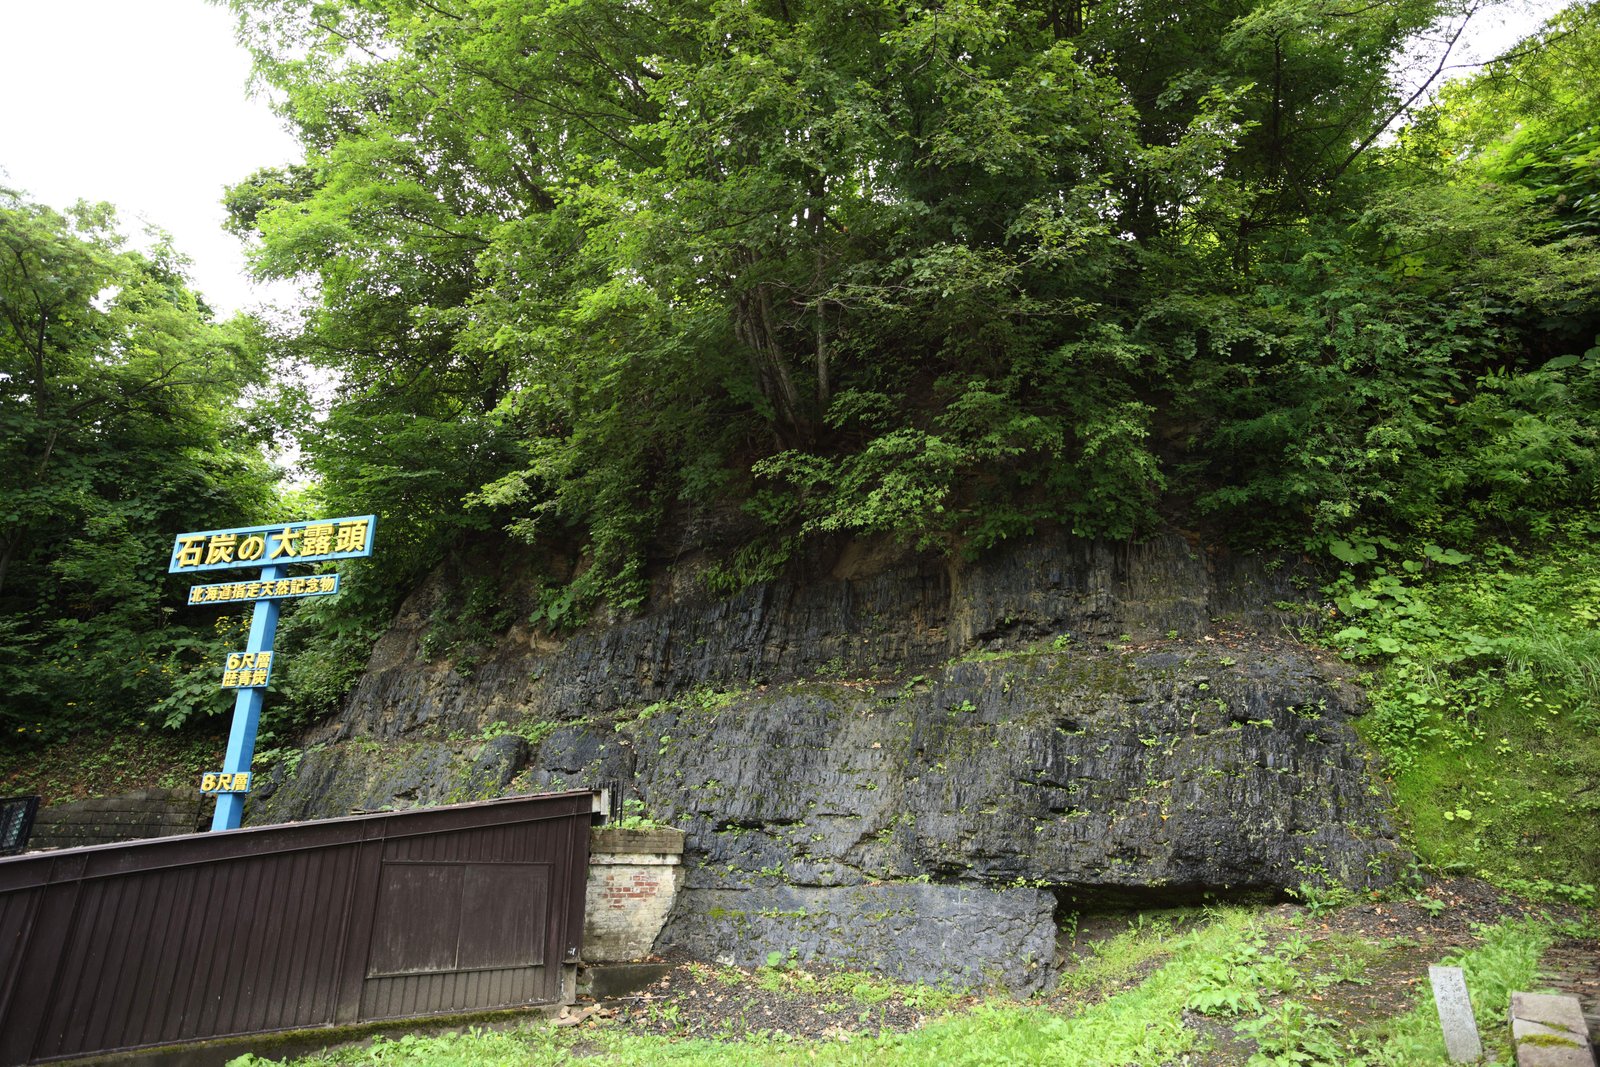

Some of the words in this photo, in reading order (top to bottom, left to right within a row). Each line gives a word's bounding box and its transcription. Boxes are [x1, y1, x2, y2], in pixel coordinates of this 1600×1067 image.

[176, 520, 369, 568] 石炭の大露頭
[190, 576, 336, 603] 北海道指定天然記念物
[227, 652, 271, 670] 6尺層
[201, 773, 249, 792] 8尺層
